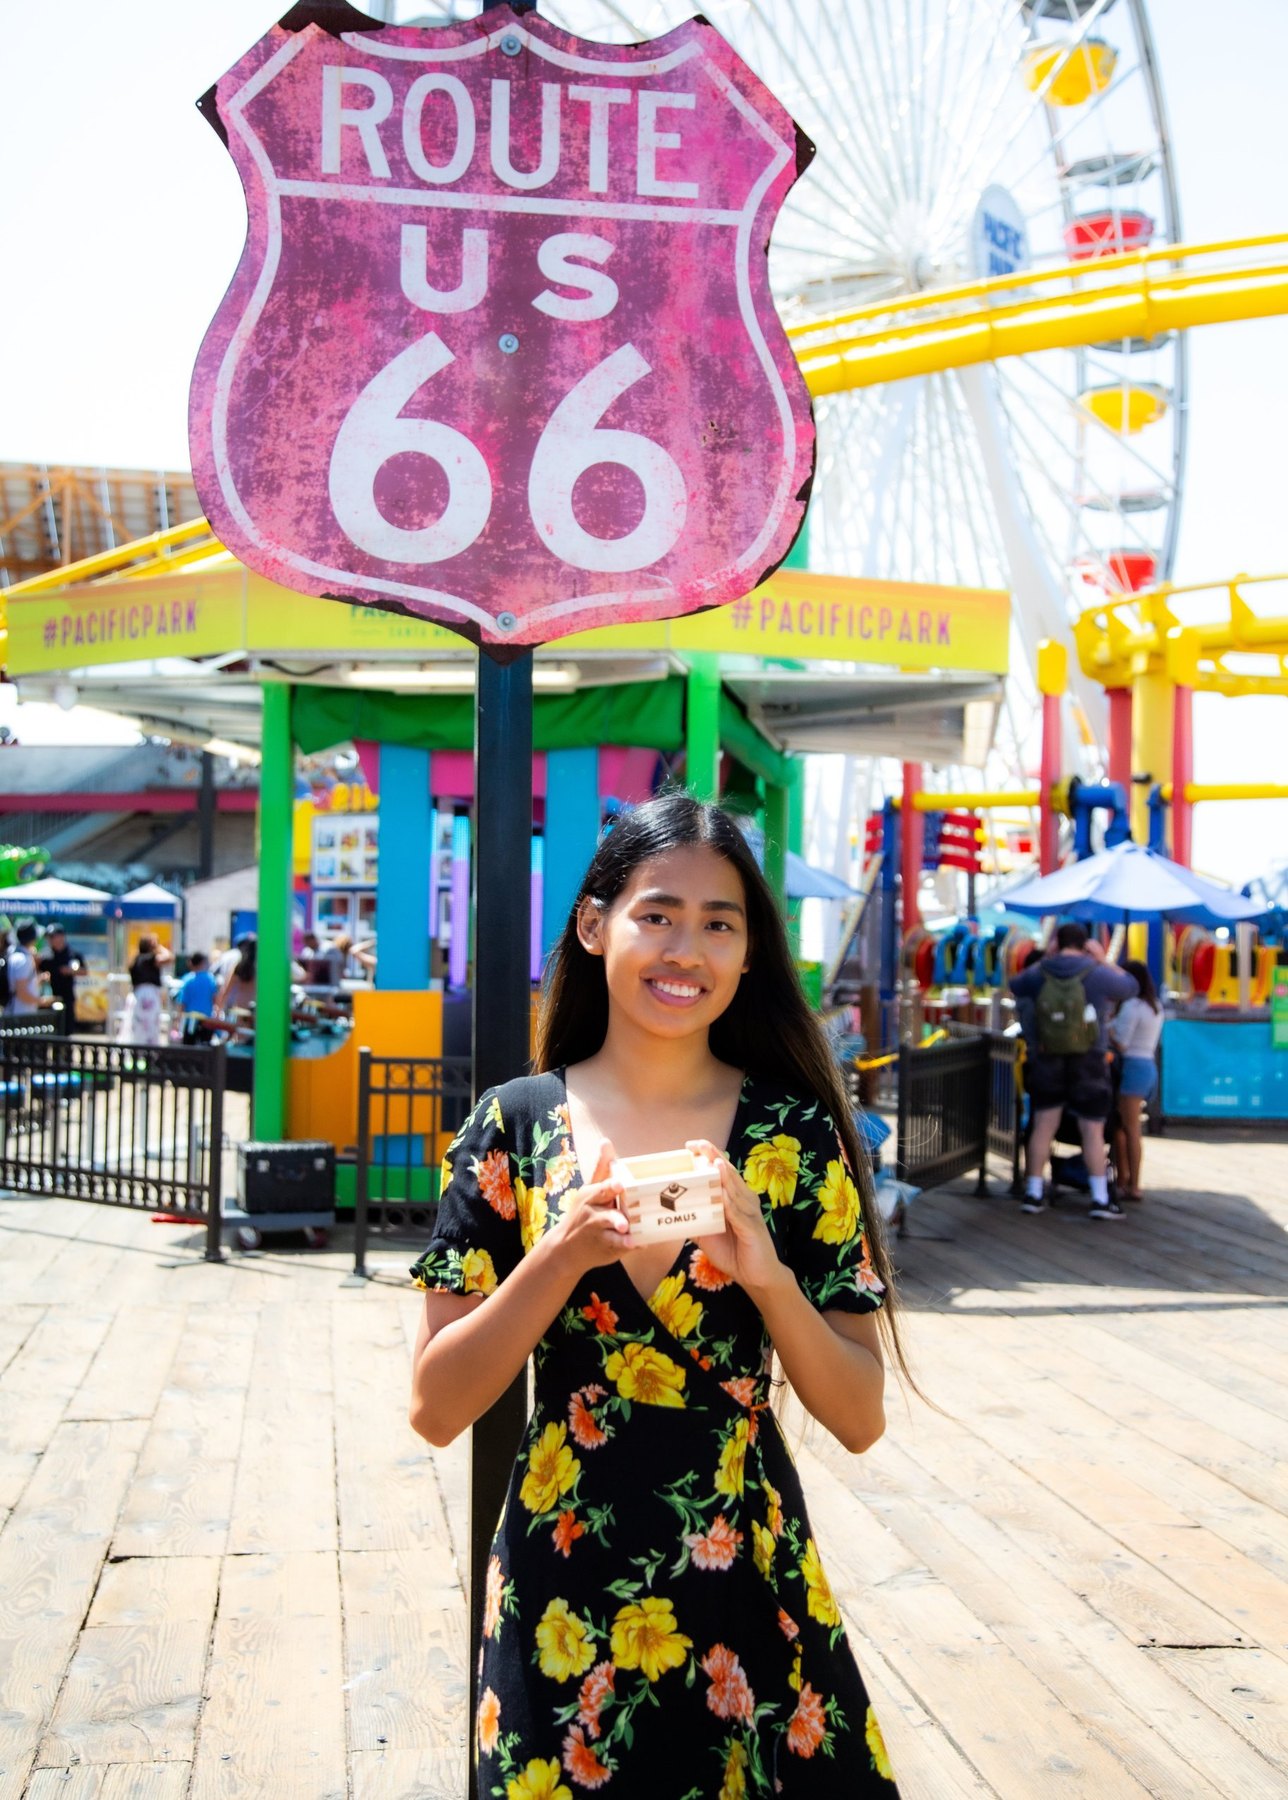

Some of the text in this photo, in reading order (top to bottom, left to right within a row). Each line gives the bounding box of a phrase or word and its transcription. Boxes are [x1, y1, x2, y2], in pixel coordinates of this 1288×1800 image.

[320, 64, 699, 199] ROUTE
[328, 330, 688, 573] 66
[44, 599, 197, 648] #PACIFICPARK
[731, 597, 952, 646] #PACIFICPARK
[657, 1213, 697, 1226] FOMUS
